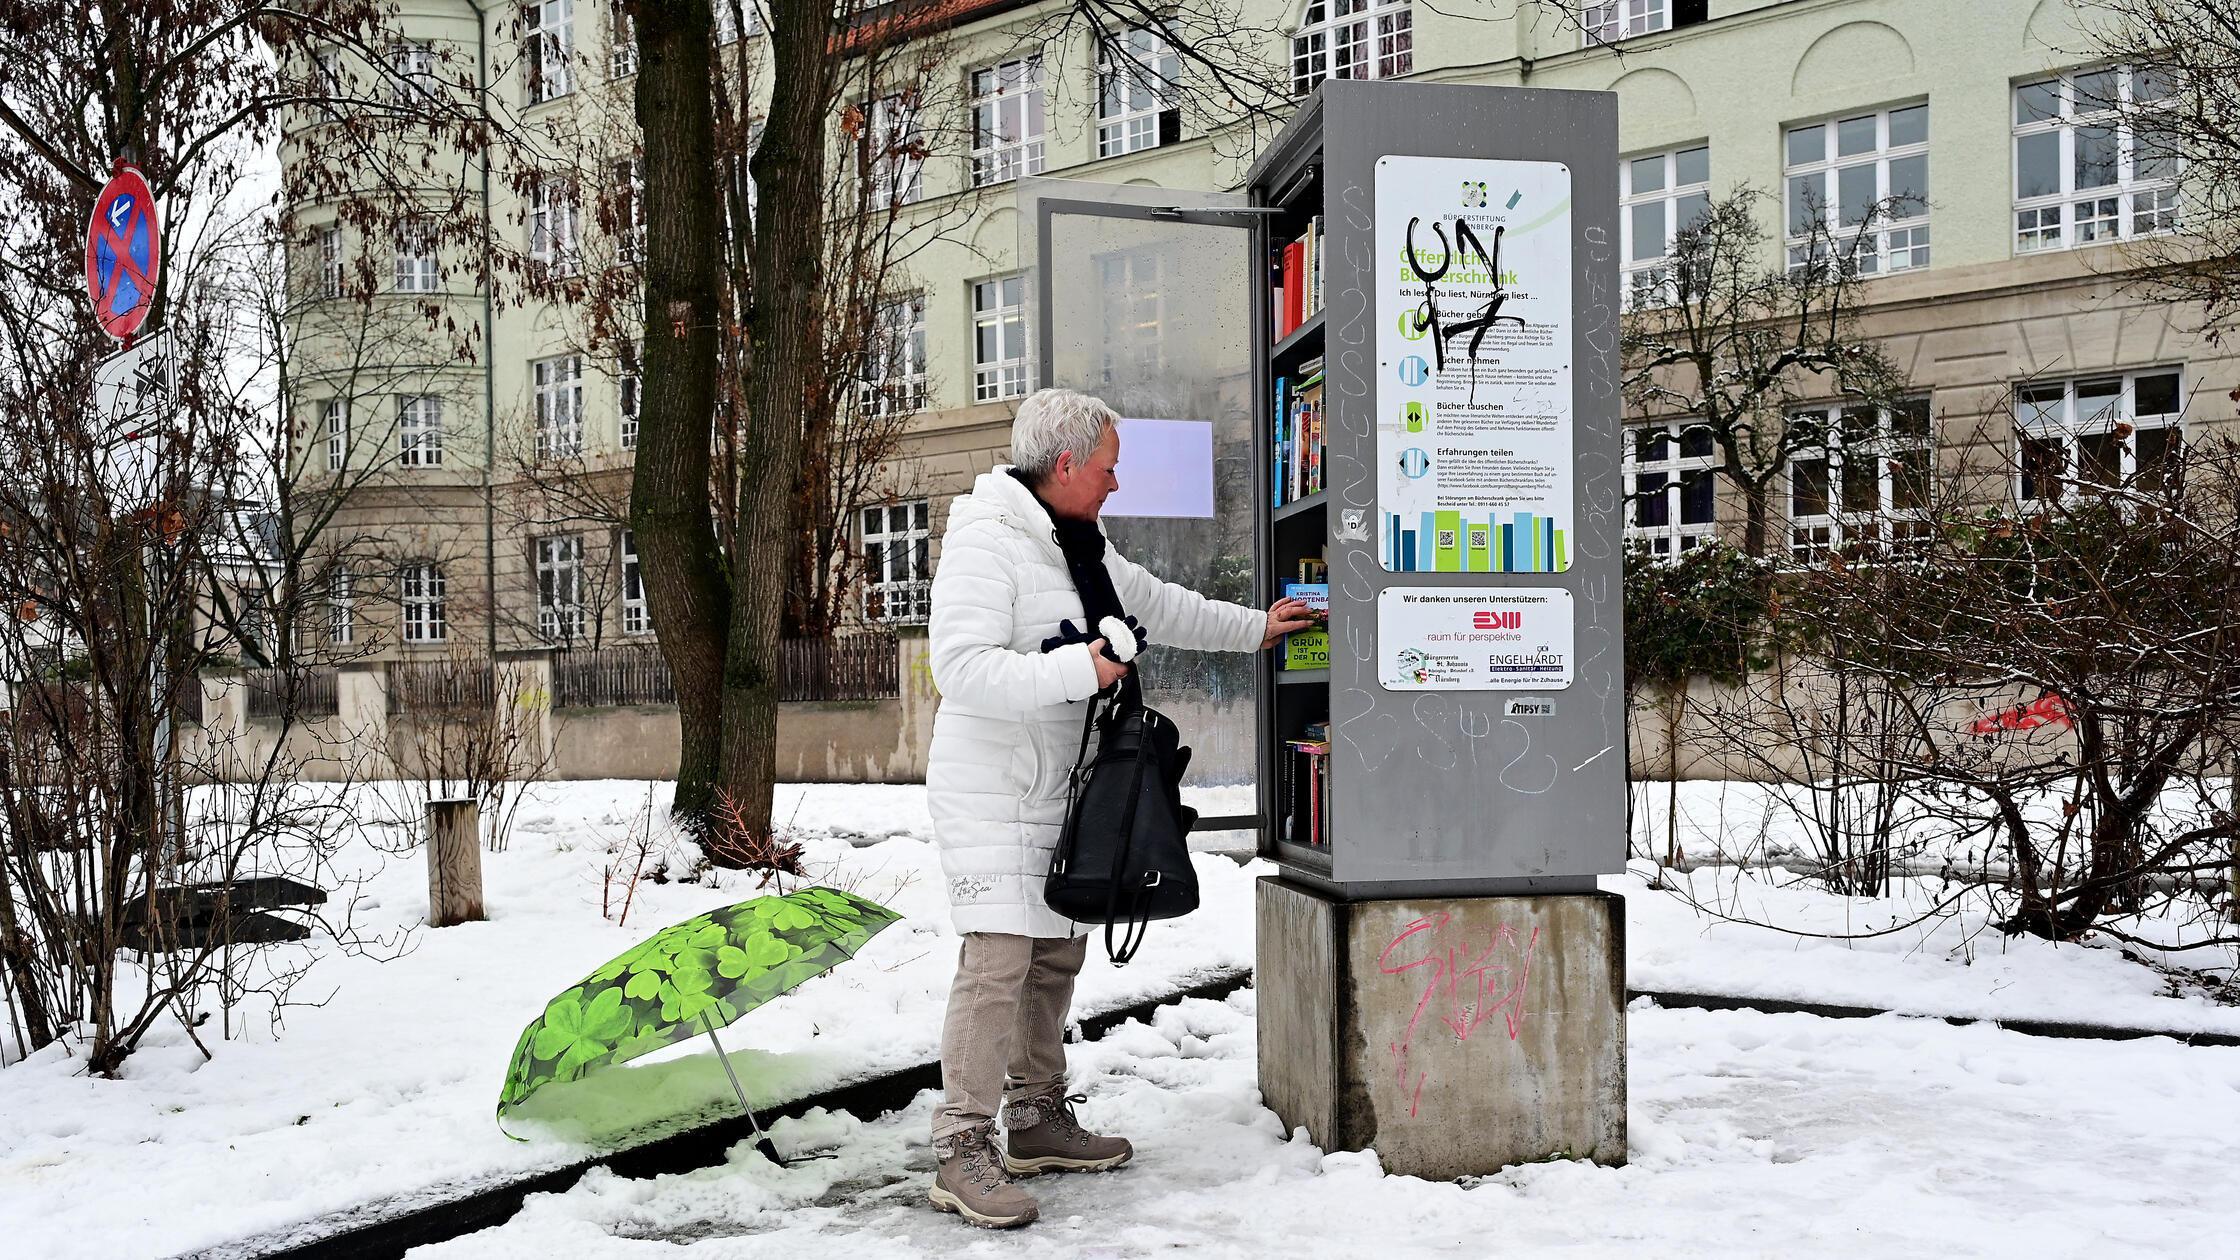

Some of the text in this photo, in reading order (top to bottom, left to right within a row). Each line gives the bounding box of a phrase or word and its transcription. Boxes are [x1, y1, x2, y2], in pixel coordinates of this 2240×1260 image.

[1400, 288, 1412, 297] Ich
[1448, 290, 1468, 299] liest,
[1511, 291, 1528, 300] liest
[1437, 402, 1464, 410] Bücher
[1437, 448, 1488, 457] Erfahrungen
[1403, 595, 1418, 603] Wir
[1420, 595, 1450, 603] danken
[1489, 595, 1548, 603] Unterstützern:
[1292, 636, 1322, 646] GRÜN
[1454, 632, 1466, 641] für
[1468, 632, 1522, 642] perspektive
[1310, 652, 1329, 661] TO
[1490, 655, 1563, 664] ENGELHARDT
